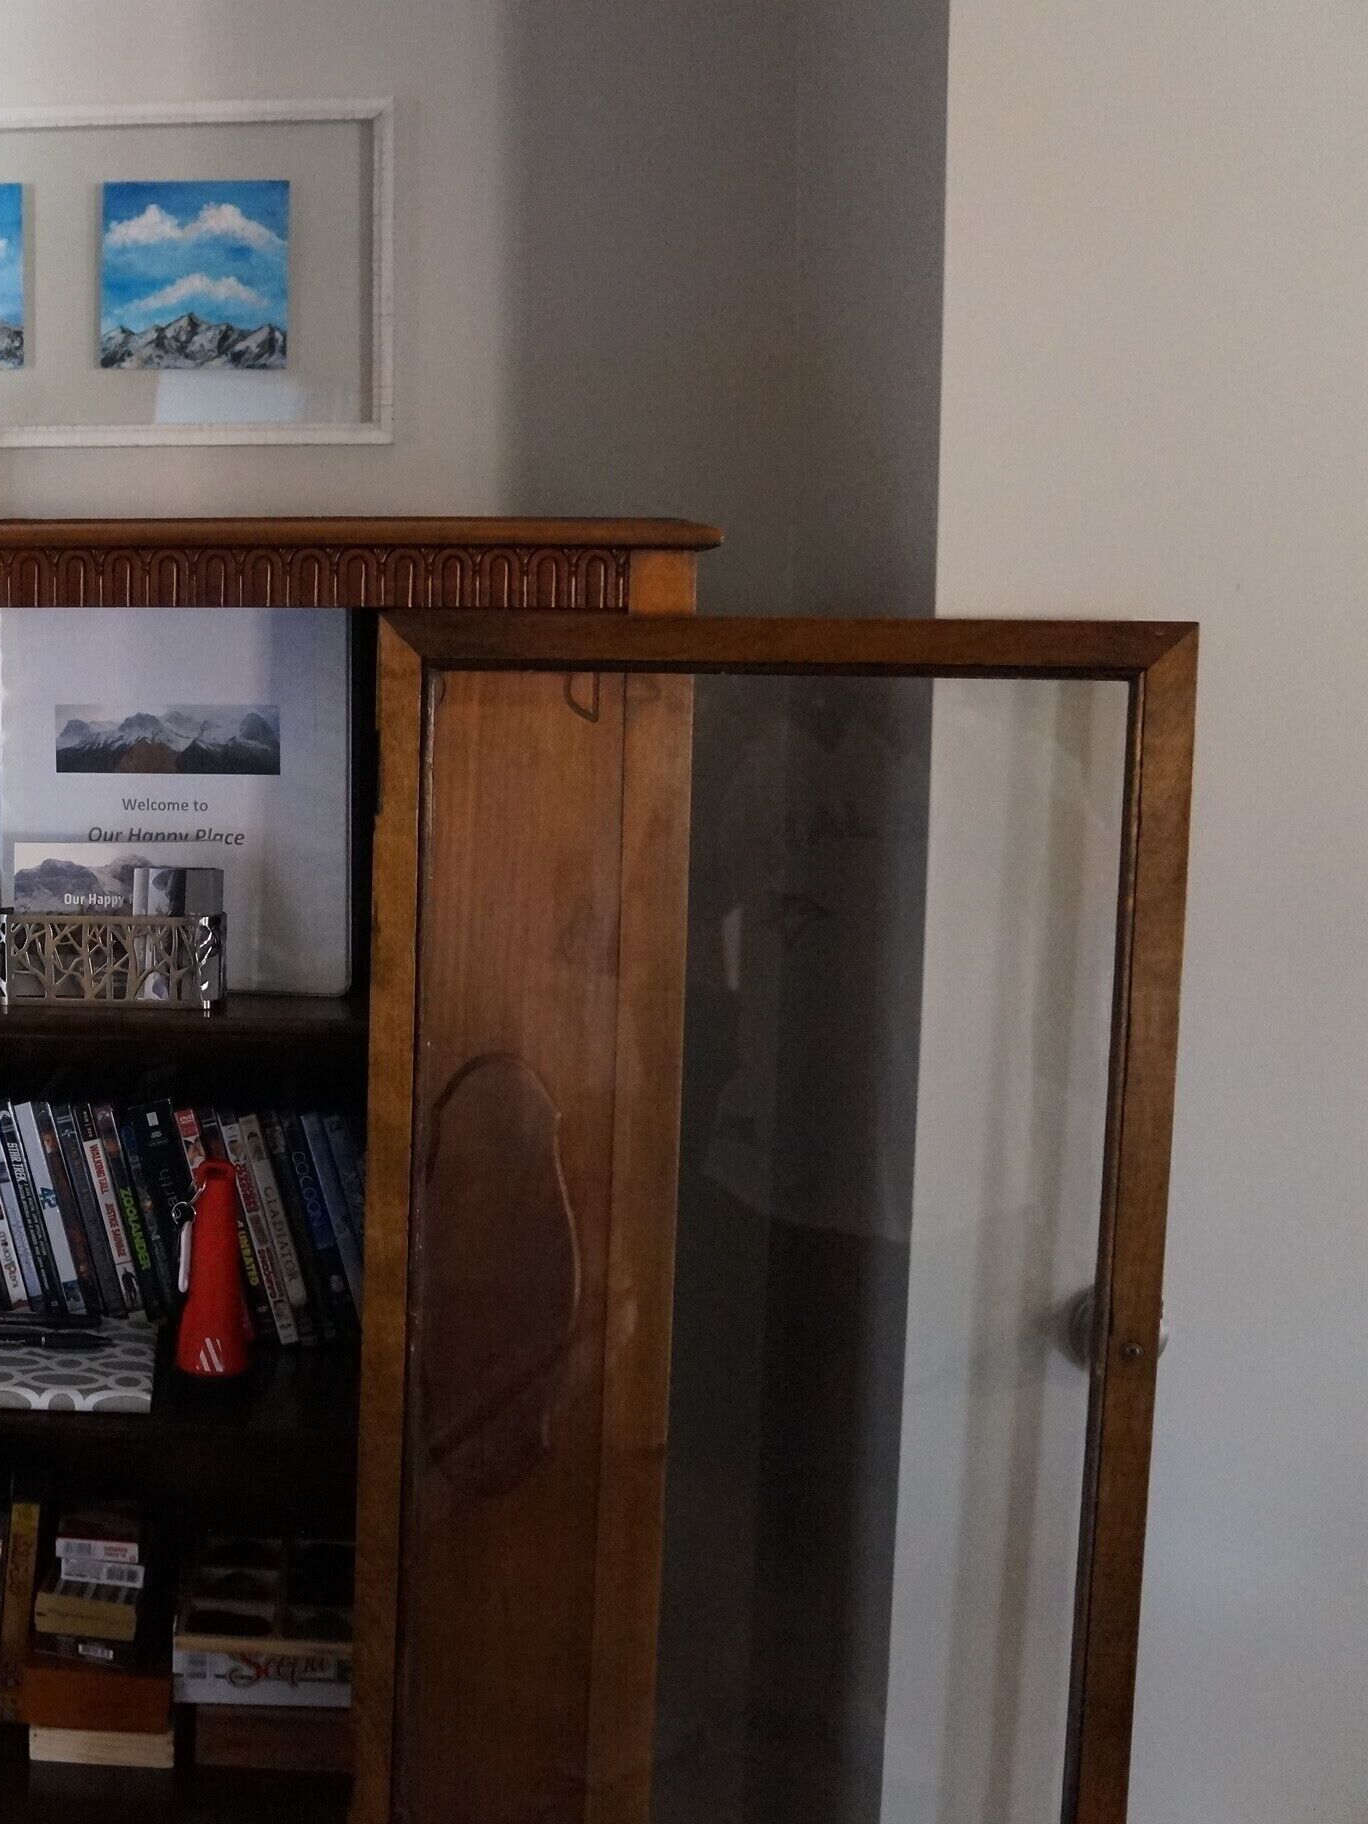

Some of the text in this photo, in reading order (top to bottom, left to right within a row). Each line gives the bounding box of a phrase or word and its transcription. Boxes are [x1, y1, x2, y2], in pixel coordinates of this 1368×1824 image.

[122, 798, 209, 811] Welcome to
[88, 826, 123, 842] Our
[64, 893, 125, 908] Our Happy
[6, 1140, 22, 1164] STAR
[88, 1143, 105, 1178] WALKING
[12, 1161, 27, 1184] TREK
[37, 1184, 59, 1210] 42
[120, 1185, 150, 1271] ZOOLANDER
[264, 1184, 297, 1282] GLADIATOR
